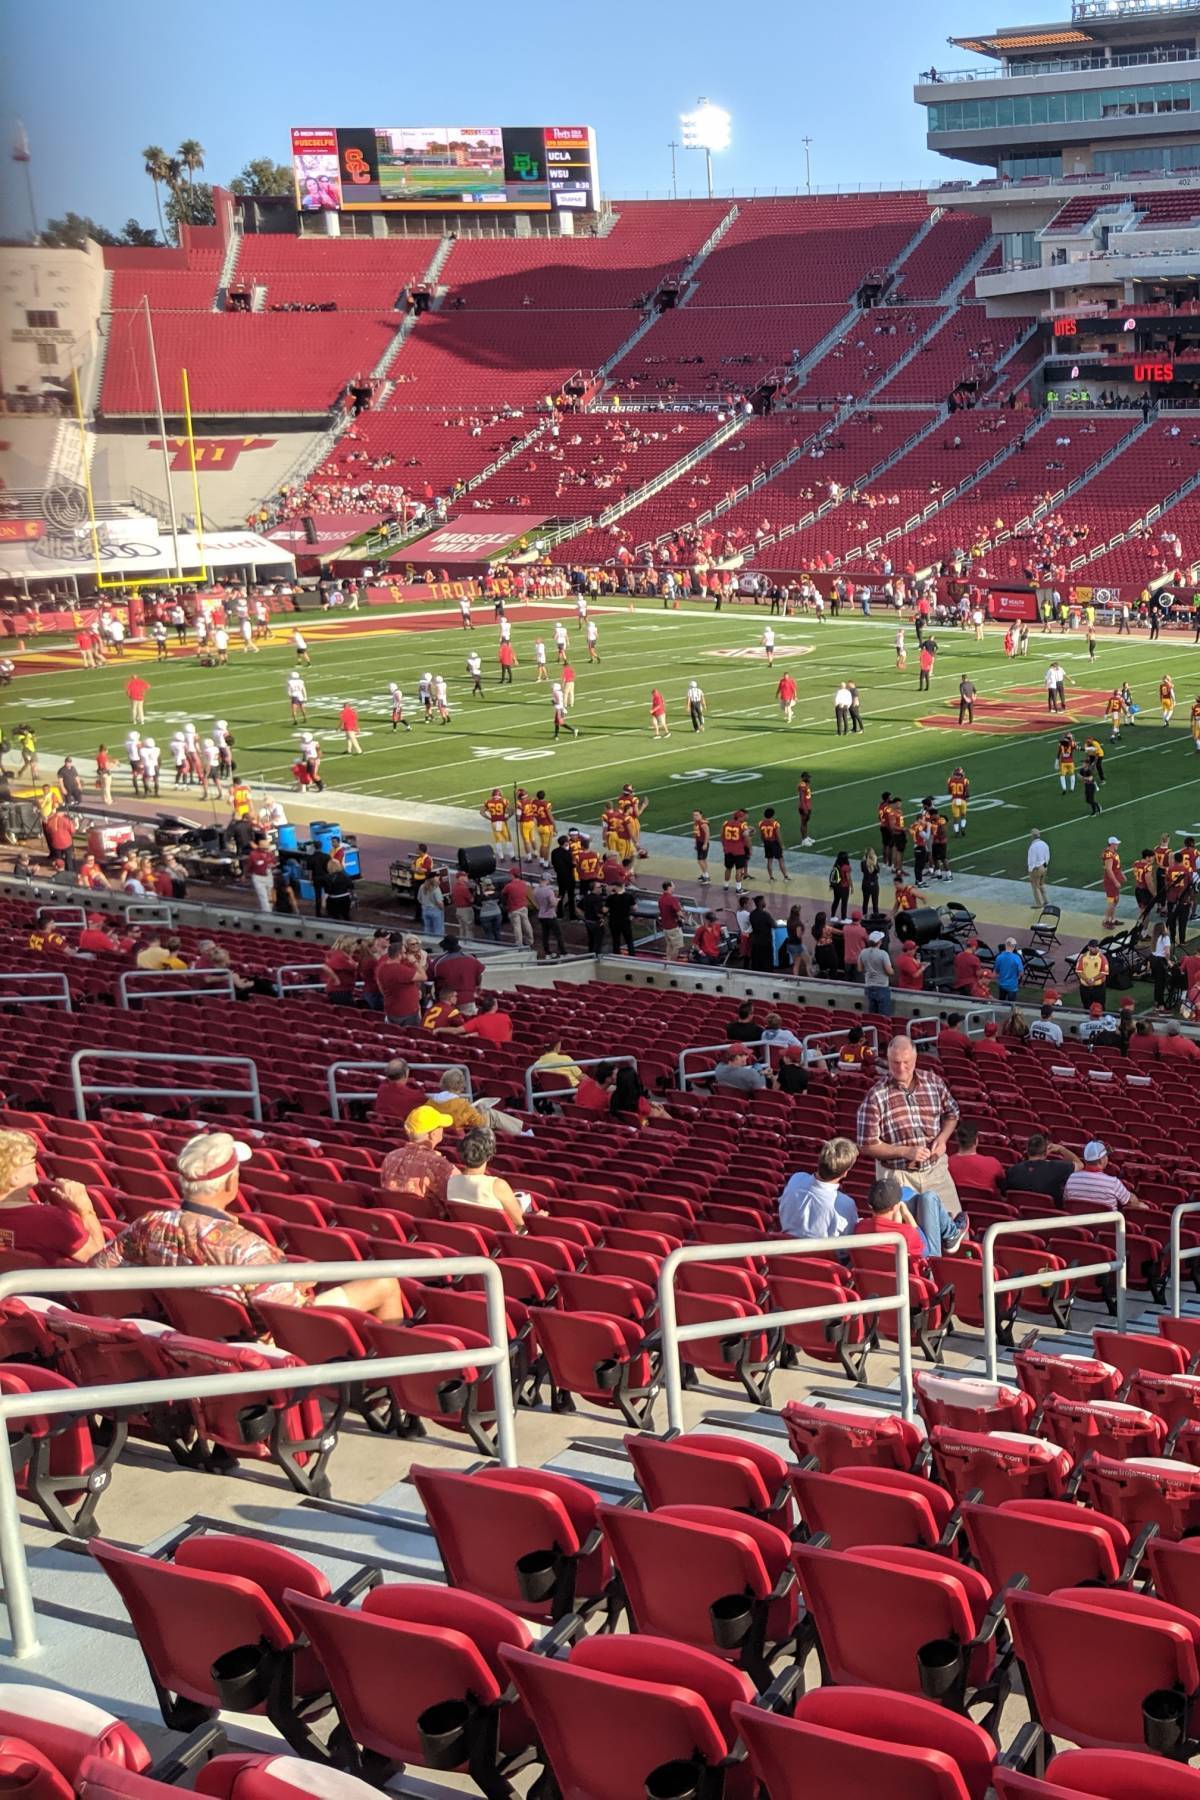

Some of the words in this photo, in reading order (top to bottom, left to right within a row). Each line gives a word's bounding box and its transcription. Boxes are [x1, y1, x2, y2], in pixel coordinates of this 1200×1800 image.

[548, 152, 571, 161] UCLA
[549, 169, 569, 179] WSU
[1054, 319, 1077, 336] UTES
[1134, 363, 1173, 381] UTES
[431, 533, 517, 544] MUSCLE
[428, 543, 486, 553] MILK
[669, 767, 765, 785] 50
[724, 827, 740, 841] 63
[581, 858, 598, 873] 47
[424, 1006, 442, 1028] 2
[323, 1435, 335, 1448] 26
[94, 1473, 107, 1488] 27
